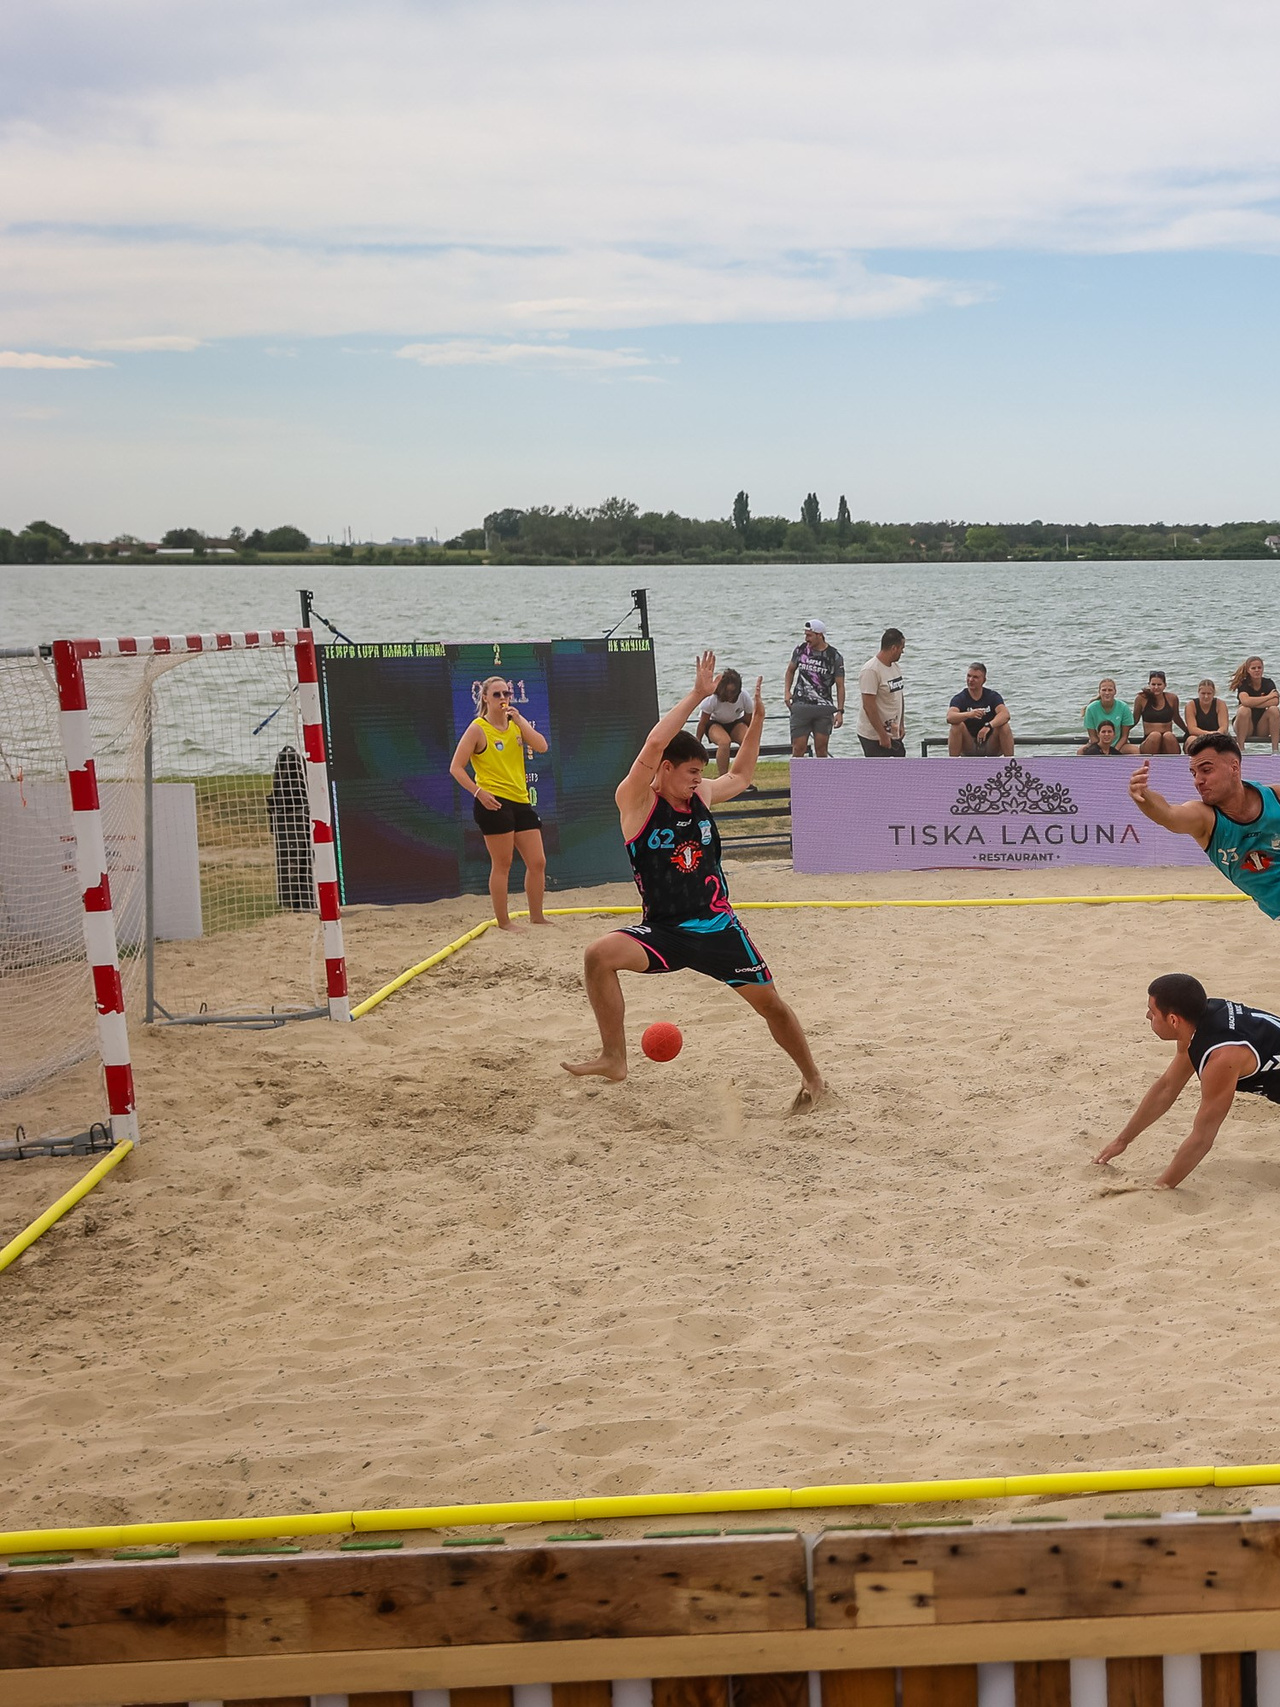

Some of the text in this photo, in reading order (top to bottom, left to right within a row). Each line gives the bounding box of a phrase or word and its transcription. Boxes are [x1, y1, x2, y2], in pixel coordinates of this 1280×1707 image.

[647, 828, 675, 849] 62
[888, 824, 1141, 846] TISKA LAGUNA
[979, 853, 1054, 862] RESTAURANT
